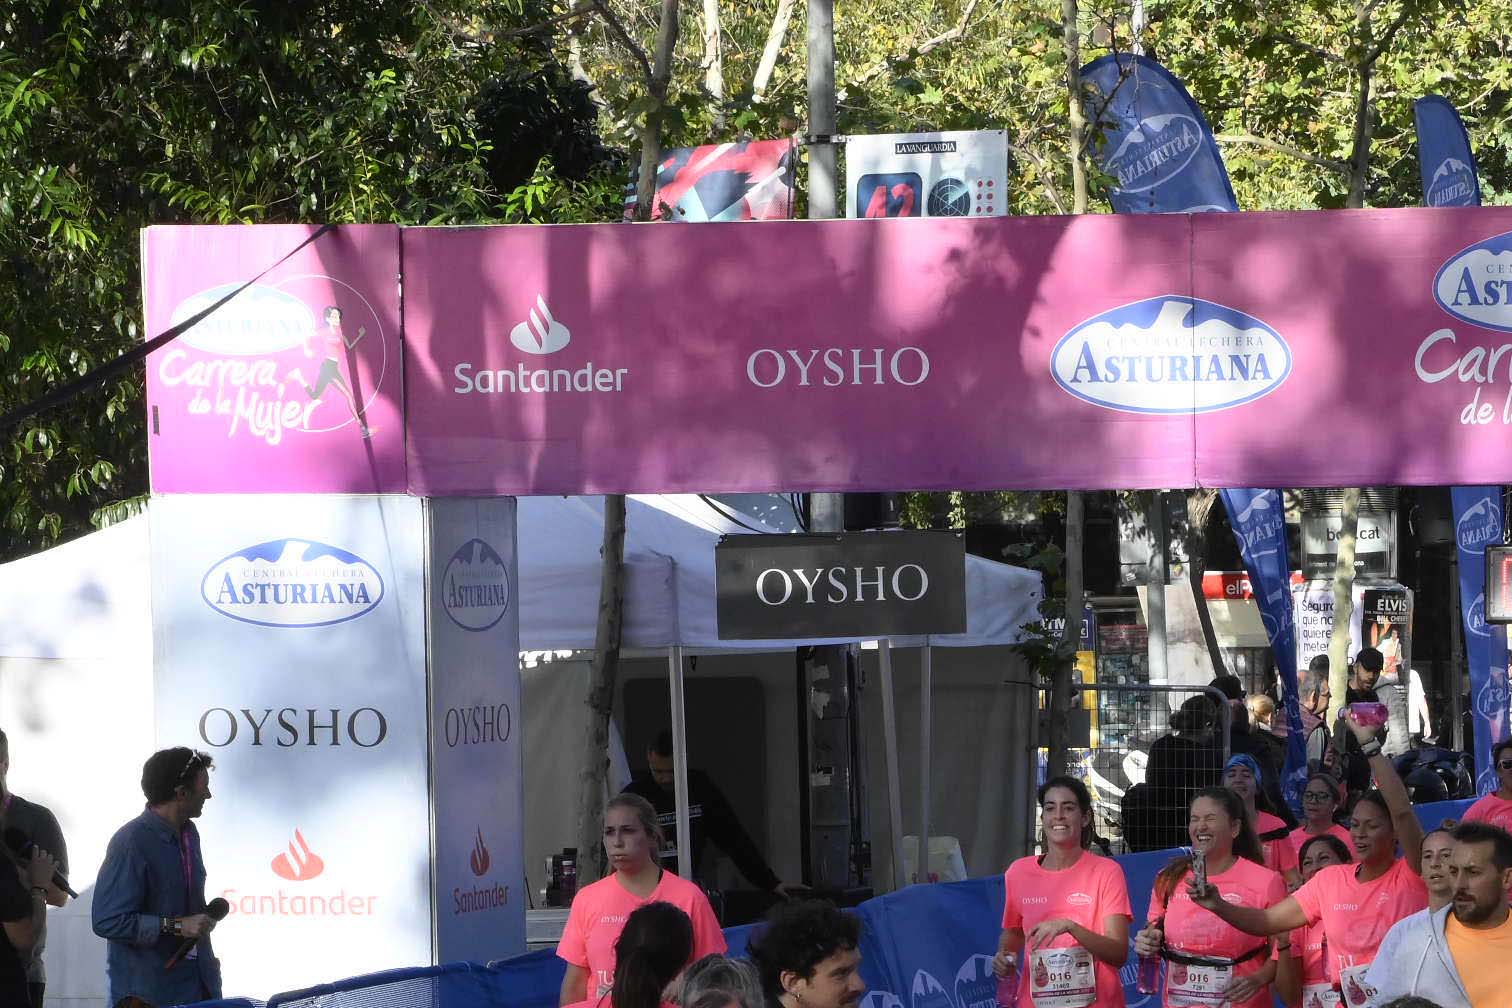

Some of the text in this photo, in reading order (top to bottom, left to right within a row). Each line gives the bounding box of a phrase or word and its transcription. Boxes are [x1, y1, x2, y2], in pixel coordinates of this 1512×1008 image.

[1193, 335, 1265, 348] LECHERA
[159, 350, 280, 388] Carrera
[454, 362, 628, 395] Santander
[746, 346, 930, 388] OYSHO
[1070, 340, 1273, 384] ASTURIANA
[215, 384, 233, 415] la
[228, 384, 323, 446] Mujer
[1460, 387, 1495, 426] de
[215, 572, 372, 605] ASTURIANA
[242, 568, 296, 578] CENTRAL
[755, 562, 929, 607] OYSHO
[447, 575, 506, 609] ASTURIANA
[1377, 600, 1408, 612] ELVIS
[1303, 616, 1319, 629] que
[198, 707, 388, 748] OYSHO
[445, 703, 511, 748] OYSHO
[220, 889, 381, 916] Santander
[453, 882, 510, 915] Santander
[1050, 971, 1072, 981] 016
